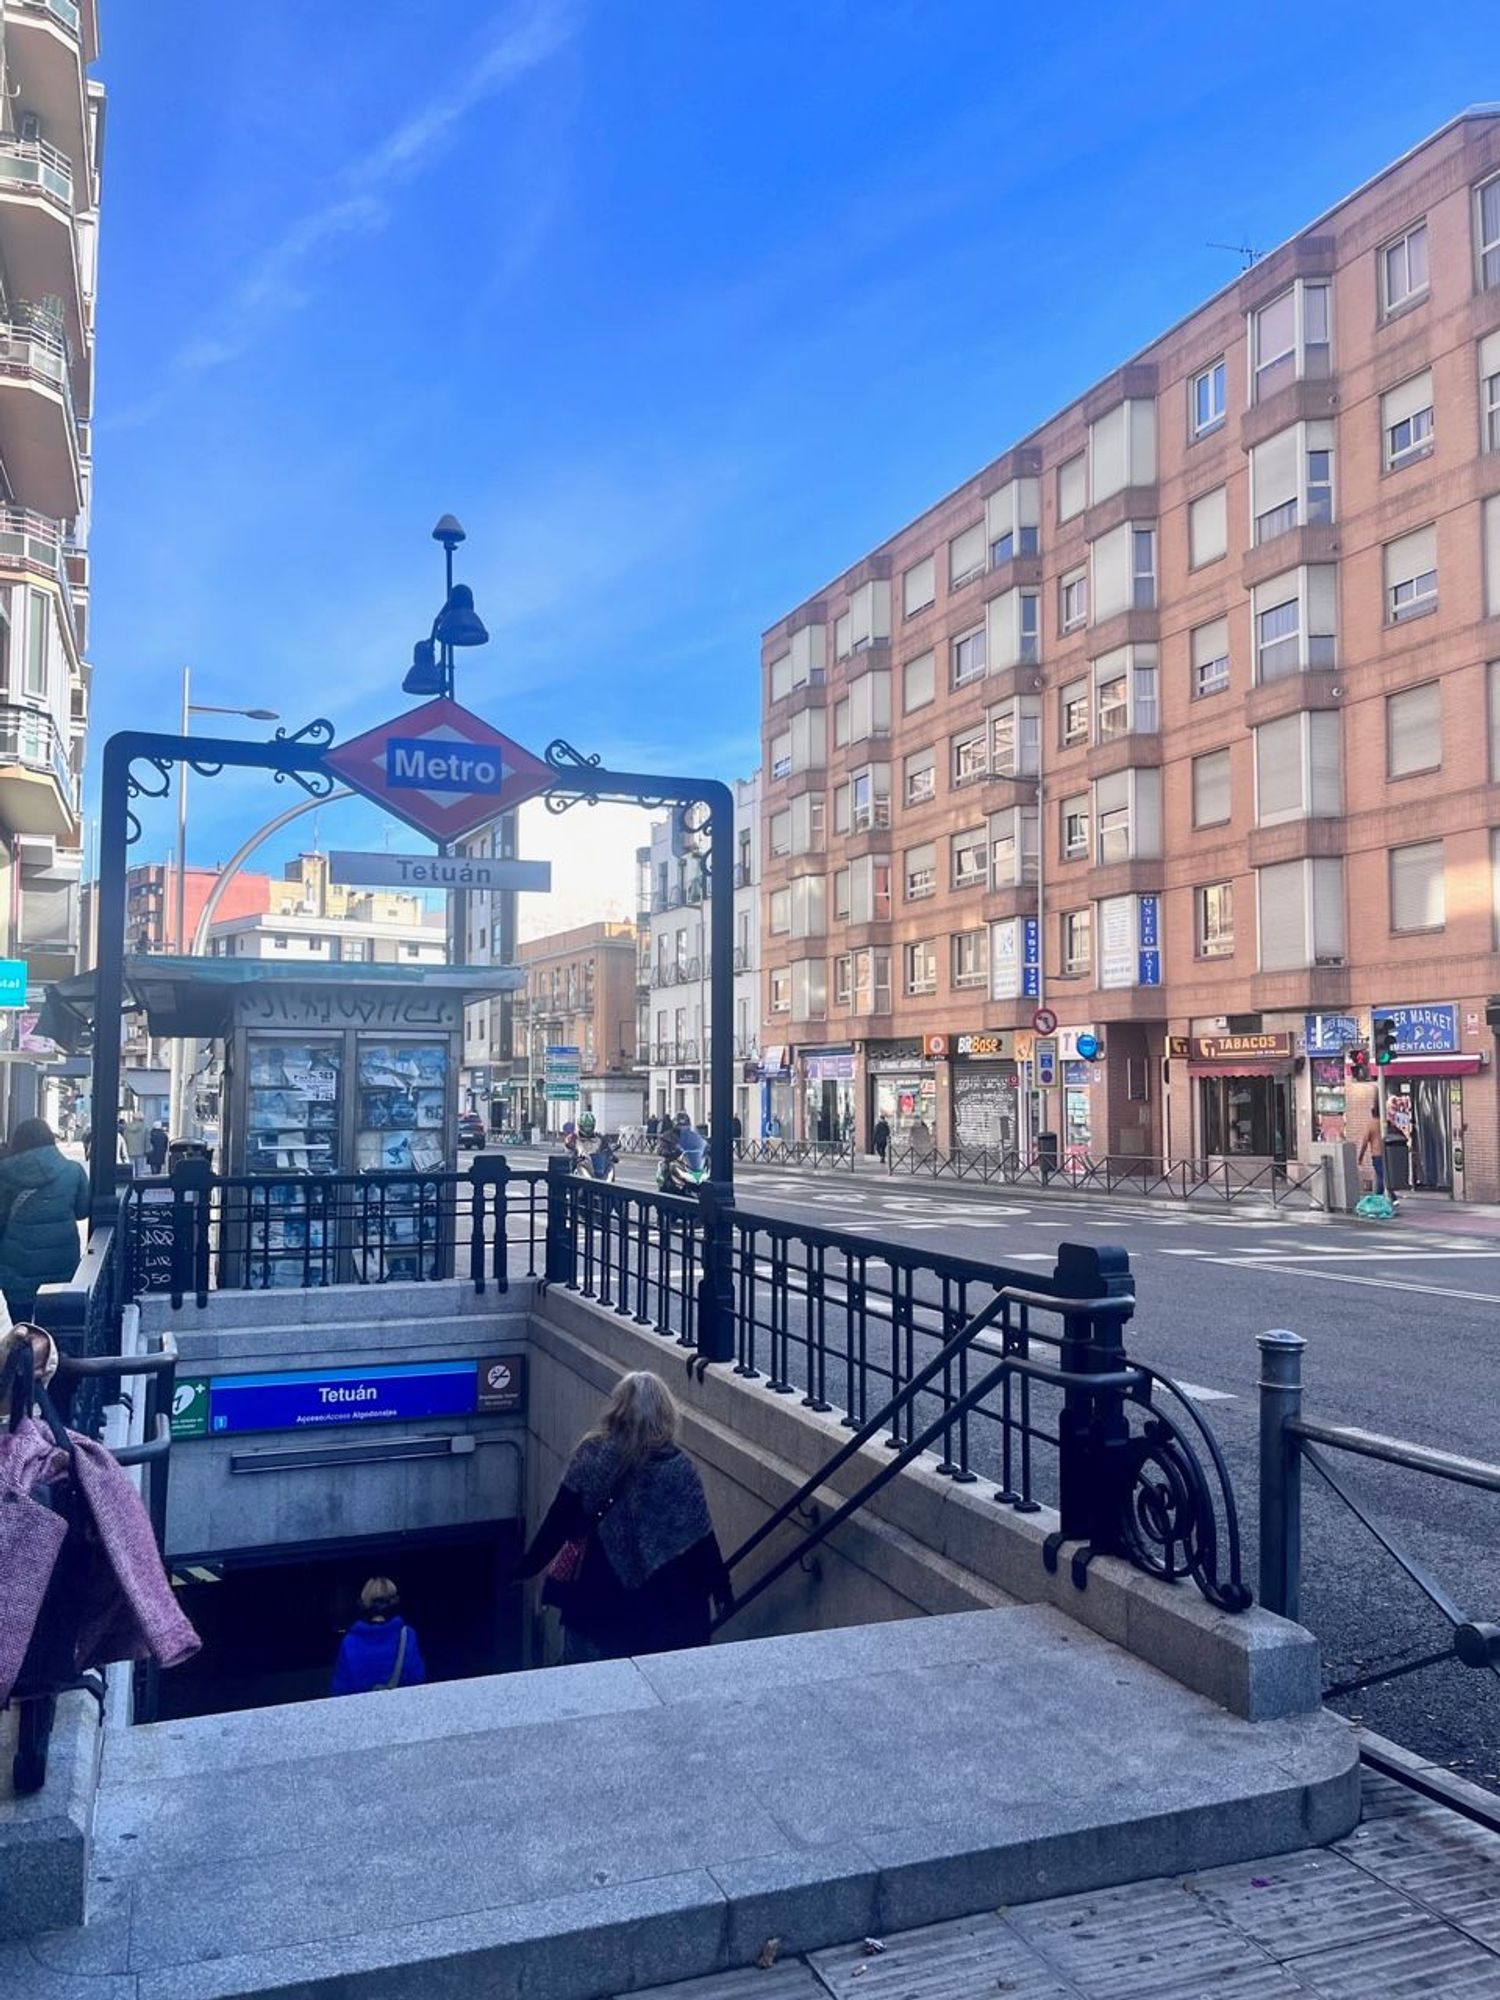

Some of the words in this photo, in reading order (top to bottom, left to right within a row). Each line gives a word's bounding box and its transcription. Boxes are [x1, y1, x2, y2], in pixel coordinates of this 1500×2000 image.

[395, 749, 495, 783] Metro
[397, 860, 491, 883] Tetuán
[1409, 1009, 1451, 1032] MARKET
[1219, 1036, 1276, 1050] TABACOS
[319, 1384, 377, 1403] Tetuán
